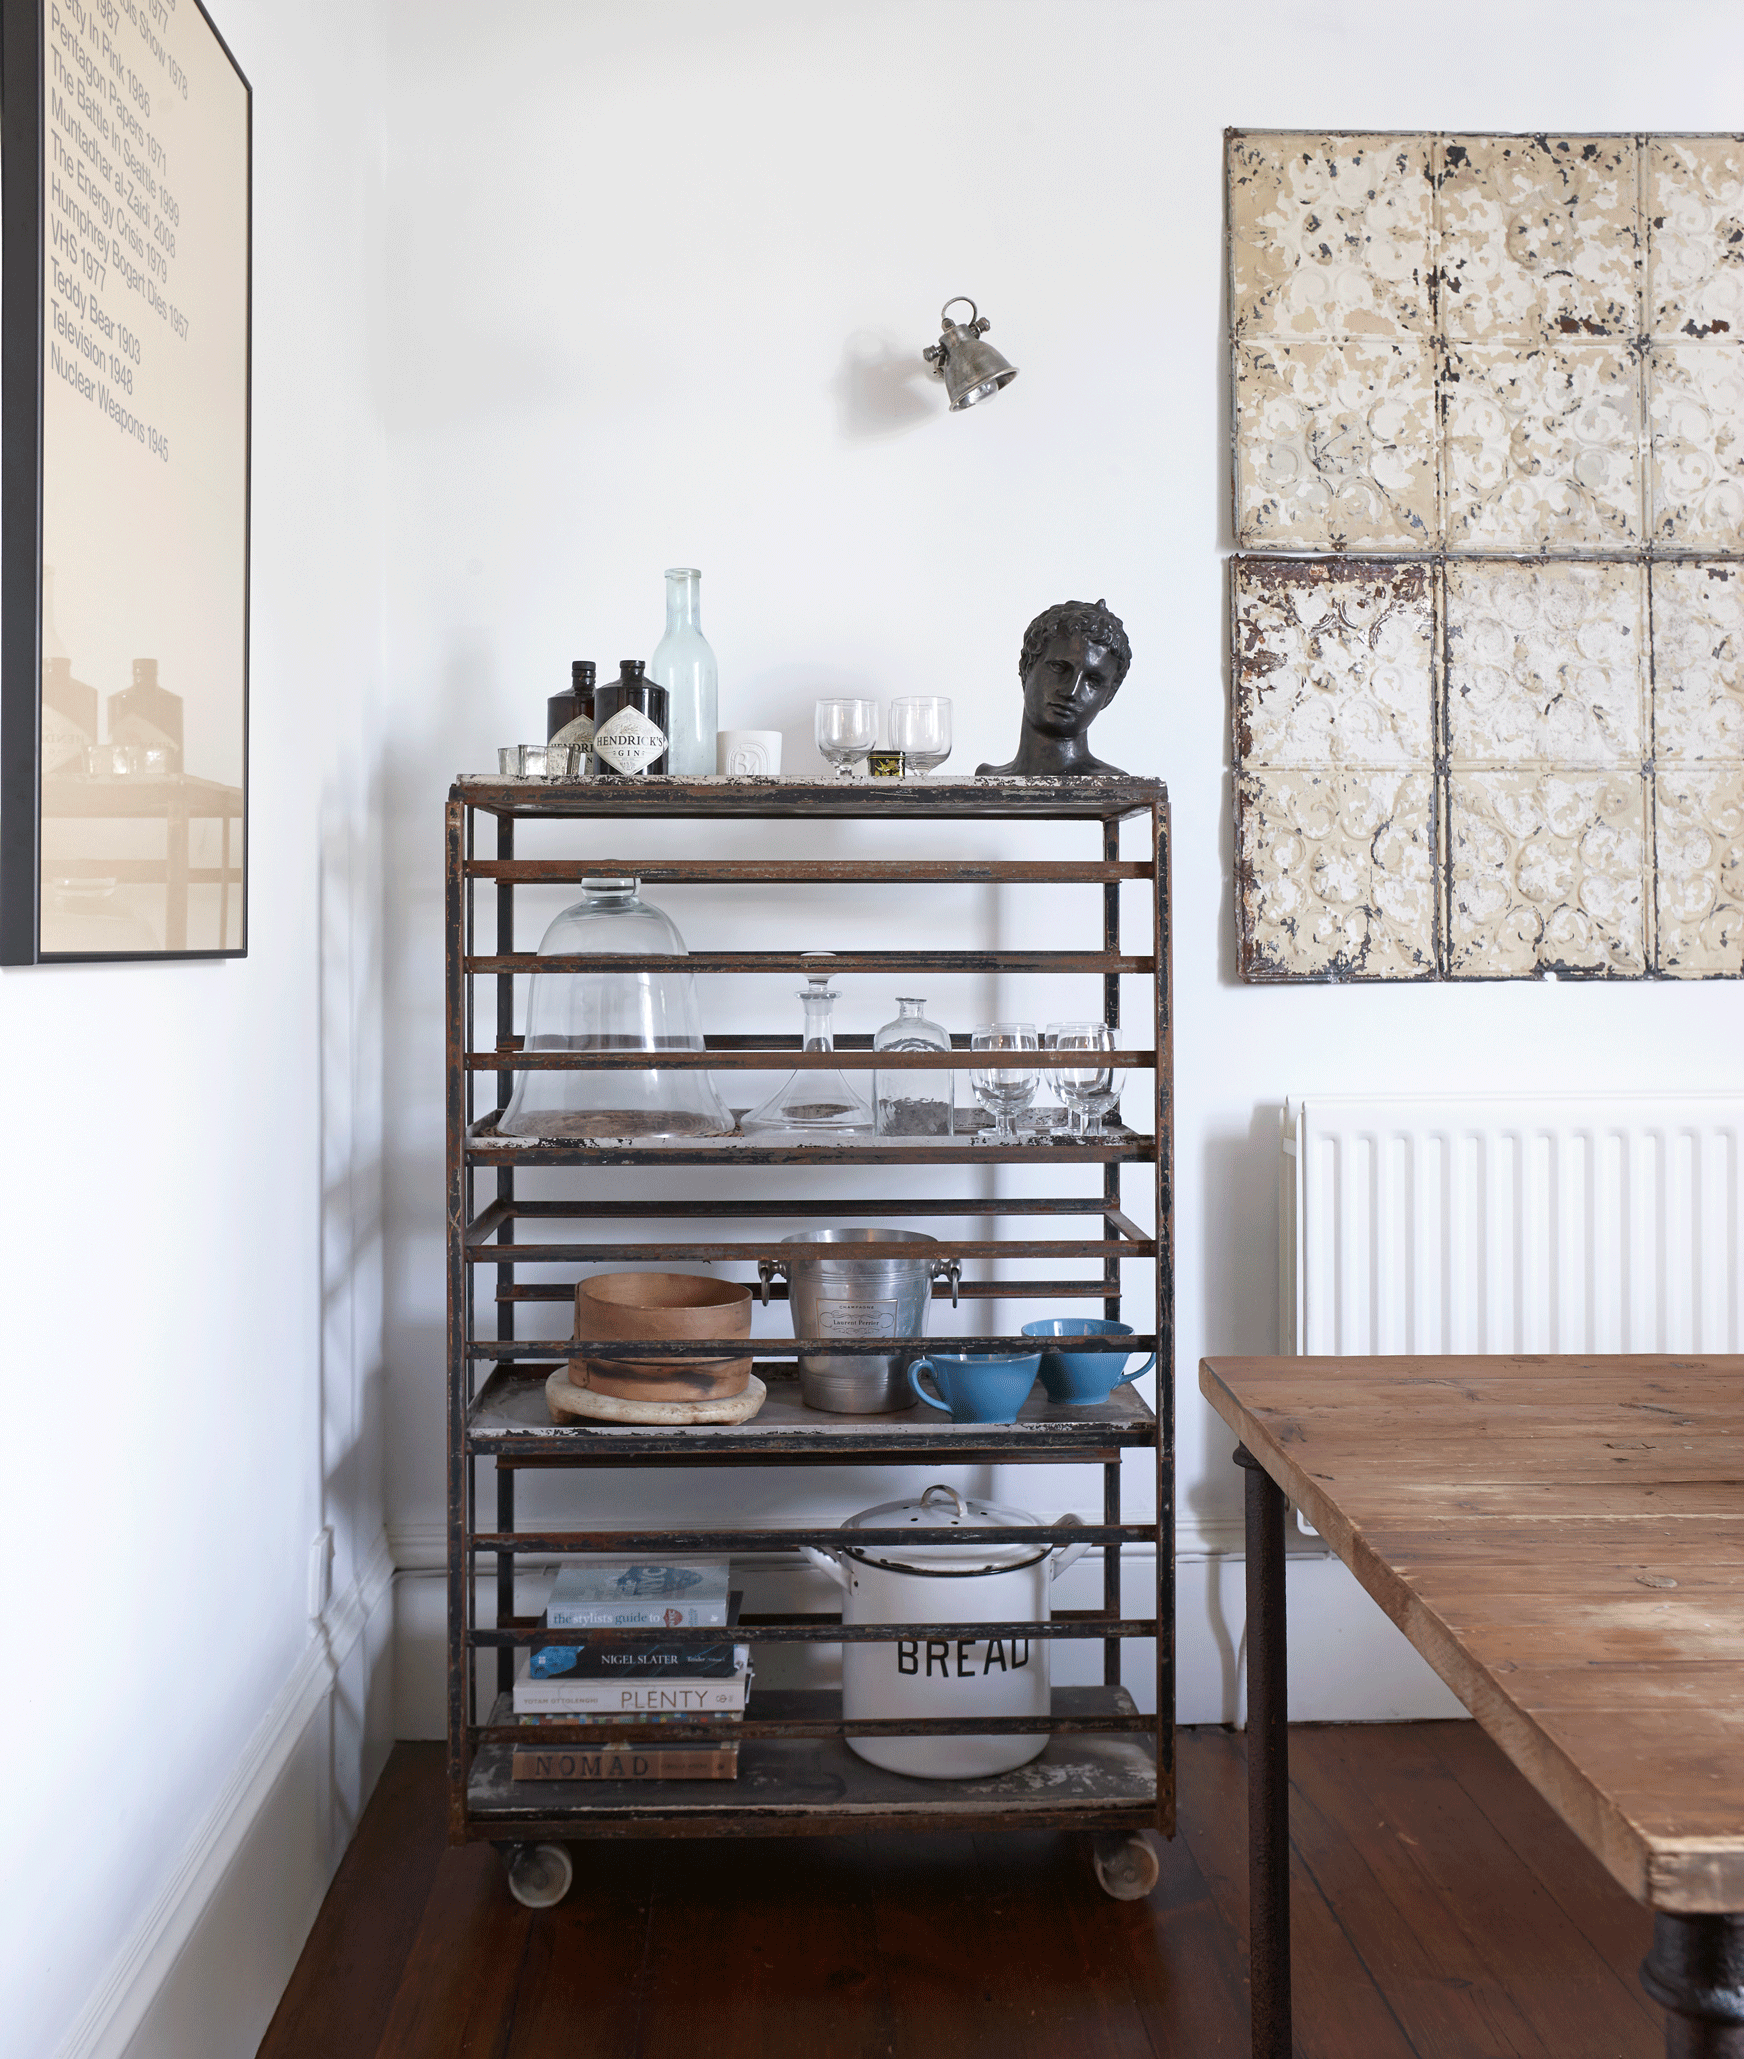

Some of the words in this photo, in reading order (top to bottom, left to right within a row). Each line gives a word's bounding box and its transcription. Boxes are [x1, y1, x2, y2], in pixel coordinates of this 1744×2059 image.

[51, 1, 106, 99] Pentagon
[110, 79, 144, 147] Papers
[146, 132, 166, 176] 1971
[90, 12, 99, 50] In
[103, 31, 125, 85] Pink
[127, 68, 150, 118] 1986
[140, 10, 165, 67] Show
[168, 54, 188, 101] 1978
[51, 43, 74, 97] The
[78, 77, 109, 140] Battle
[112, 121, 121, 156] In
[123, 138, 156, 199] Seattle
[159, 185, 180, 227] 1999
[51, 86, 113, 183] Muntadhar
[115, 172, 150, 229] al-Zaidi
[154, 214, 176, 258] 2008
[51, 128, 74, 178] The
[78, 159, 115, 230] Energy
[117, 208, 143, 258] Crisis
[146, 243, 167, 284] 1979
[51, 213, 78, 265] VHS
[81, 247, 107, 292] 1977
[51, 171, 110, 263] Humphrey
[112, 239, 146, 298] Bogart
[148, 278, 167, 320] Dies
[170, 304, 189, 341] 1957
[51, 255, 87, 320] Teddy
[90, 293, 115, 340] Bear
[117, 323, 140, 365] 1903
[51, 297, 106, 373] Television
[109, 353, 133, 395] 1948
[51, 341, 96, 402] Nuclear
[98, 380, 145, 443] Weapons
[147, 425, 169, 463] 1945
[596, 735, 663, 747] HENDRICK'S
[618, 749, 640, 757] GIN
[553, 1612, 571, 1624] the
[572, 1612, 613, 1626] stylists
[615, 1612, 648, 1625] guide
[649, 1613, 661, 1623] to
[601, 1655, 636, 1665] NIGEL
[637, 1655, 679, 1665] SLATER
[897, 1638, 1029, 1678] BREAD
[620, 1690, 709, 1709] PLENTY
[535, 1755, 649, 1777] NOMAD
